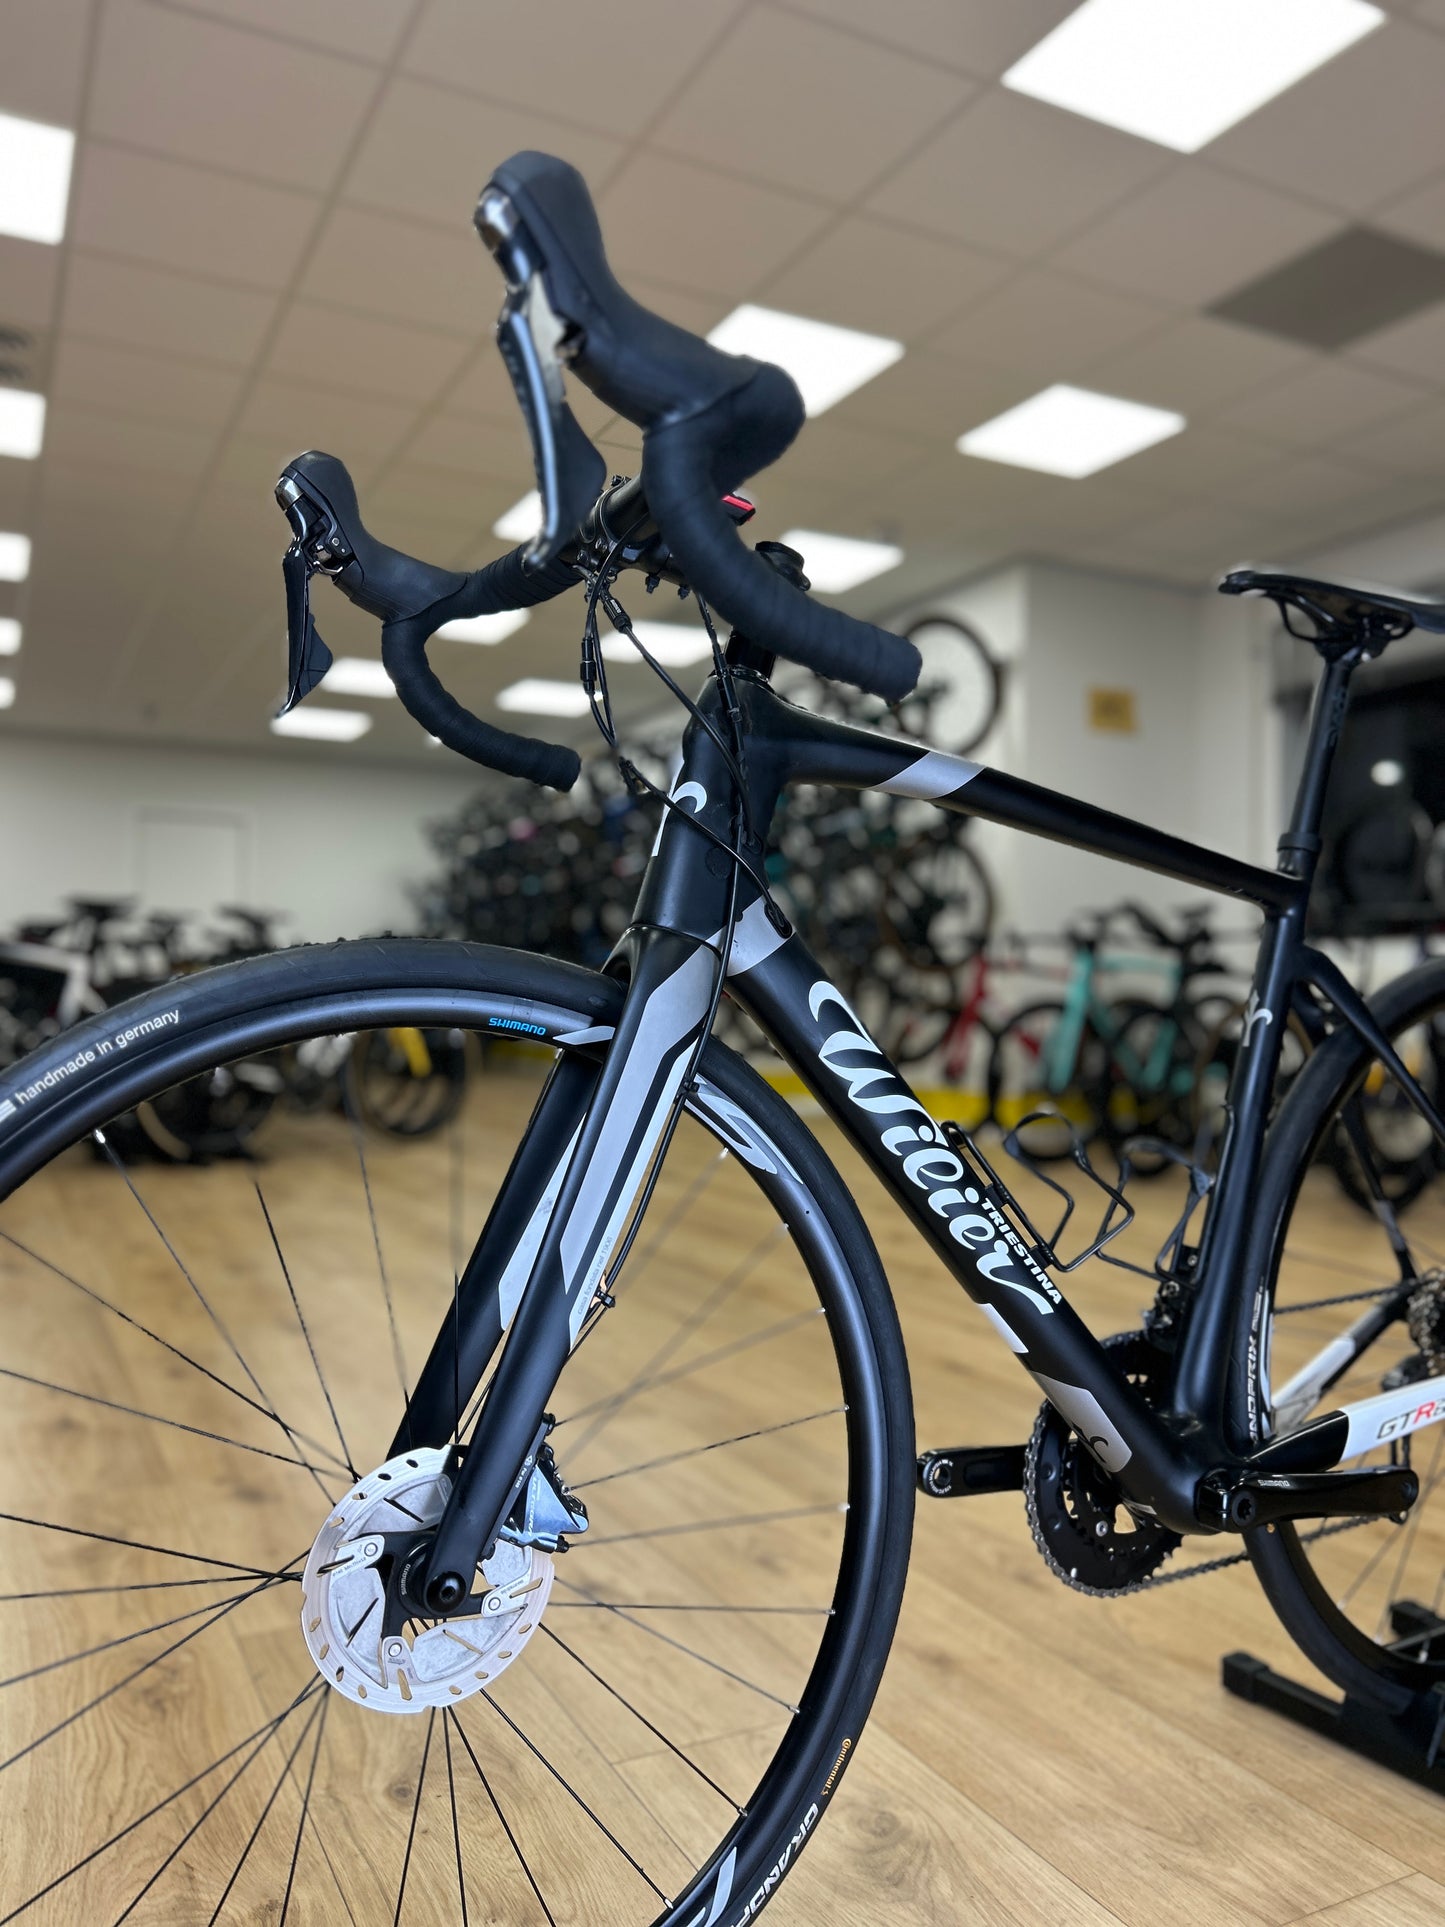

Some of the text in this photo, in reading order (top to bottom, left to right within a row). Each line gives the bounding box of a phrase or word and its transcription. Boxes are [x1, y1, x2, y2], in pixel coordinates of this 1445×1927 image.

[15, 1009, 180, 1104] handmade in germany
[489, 1017, 546, 1036] SHIMANO
[981, 1197, 1062, 1305] TRIESTINA
[578, 1295, 588, 1315] casa
[584, 1267, 600, 1296] fondata
[824, 1738, 852, 1790] Continental
[730, 1803, 819, 1927] GRANDP
